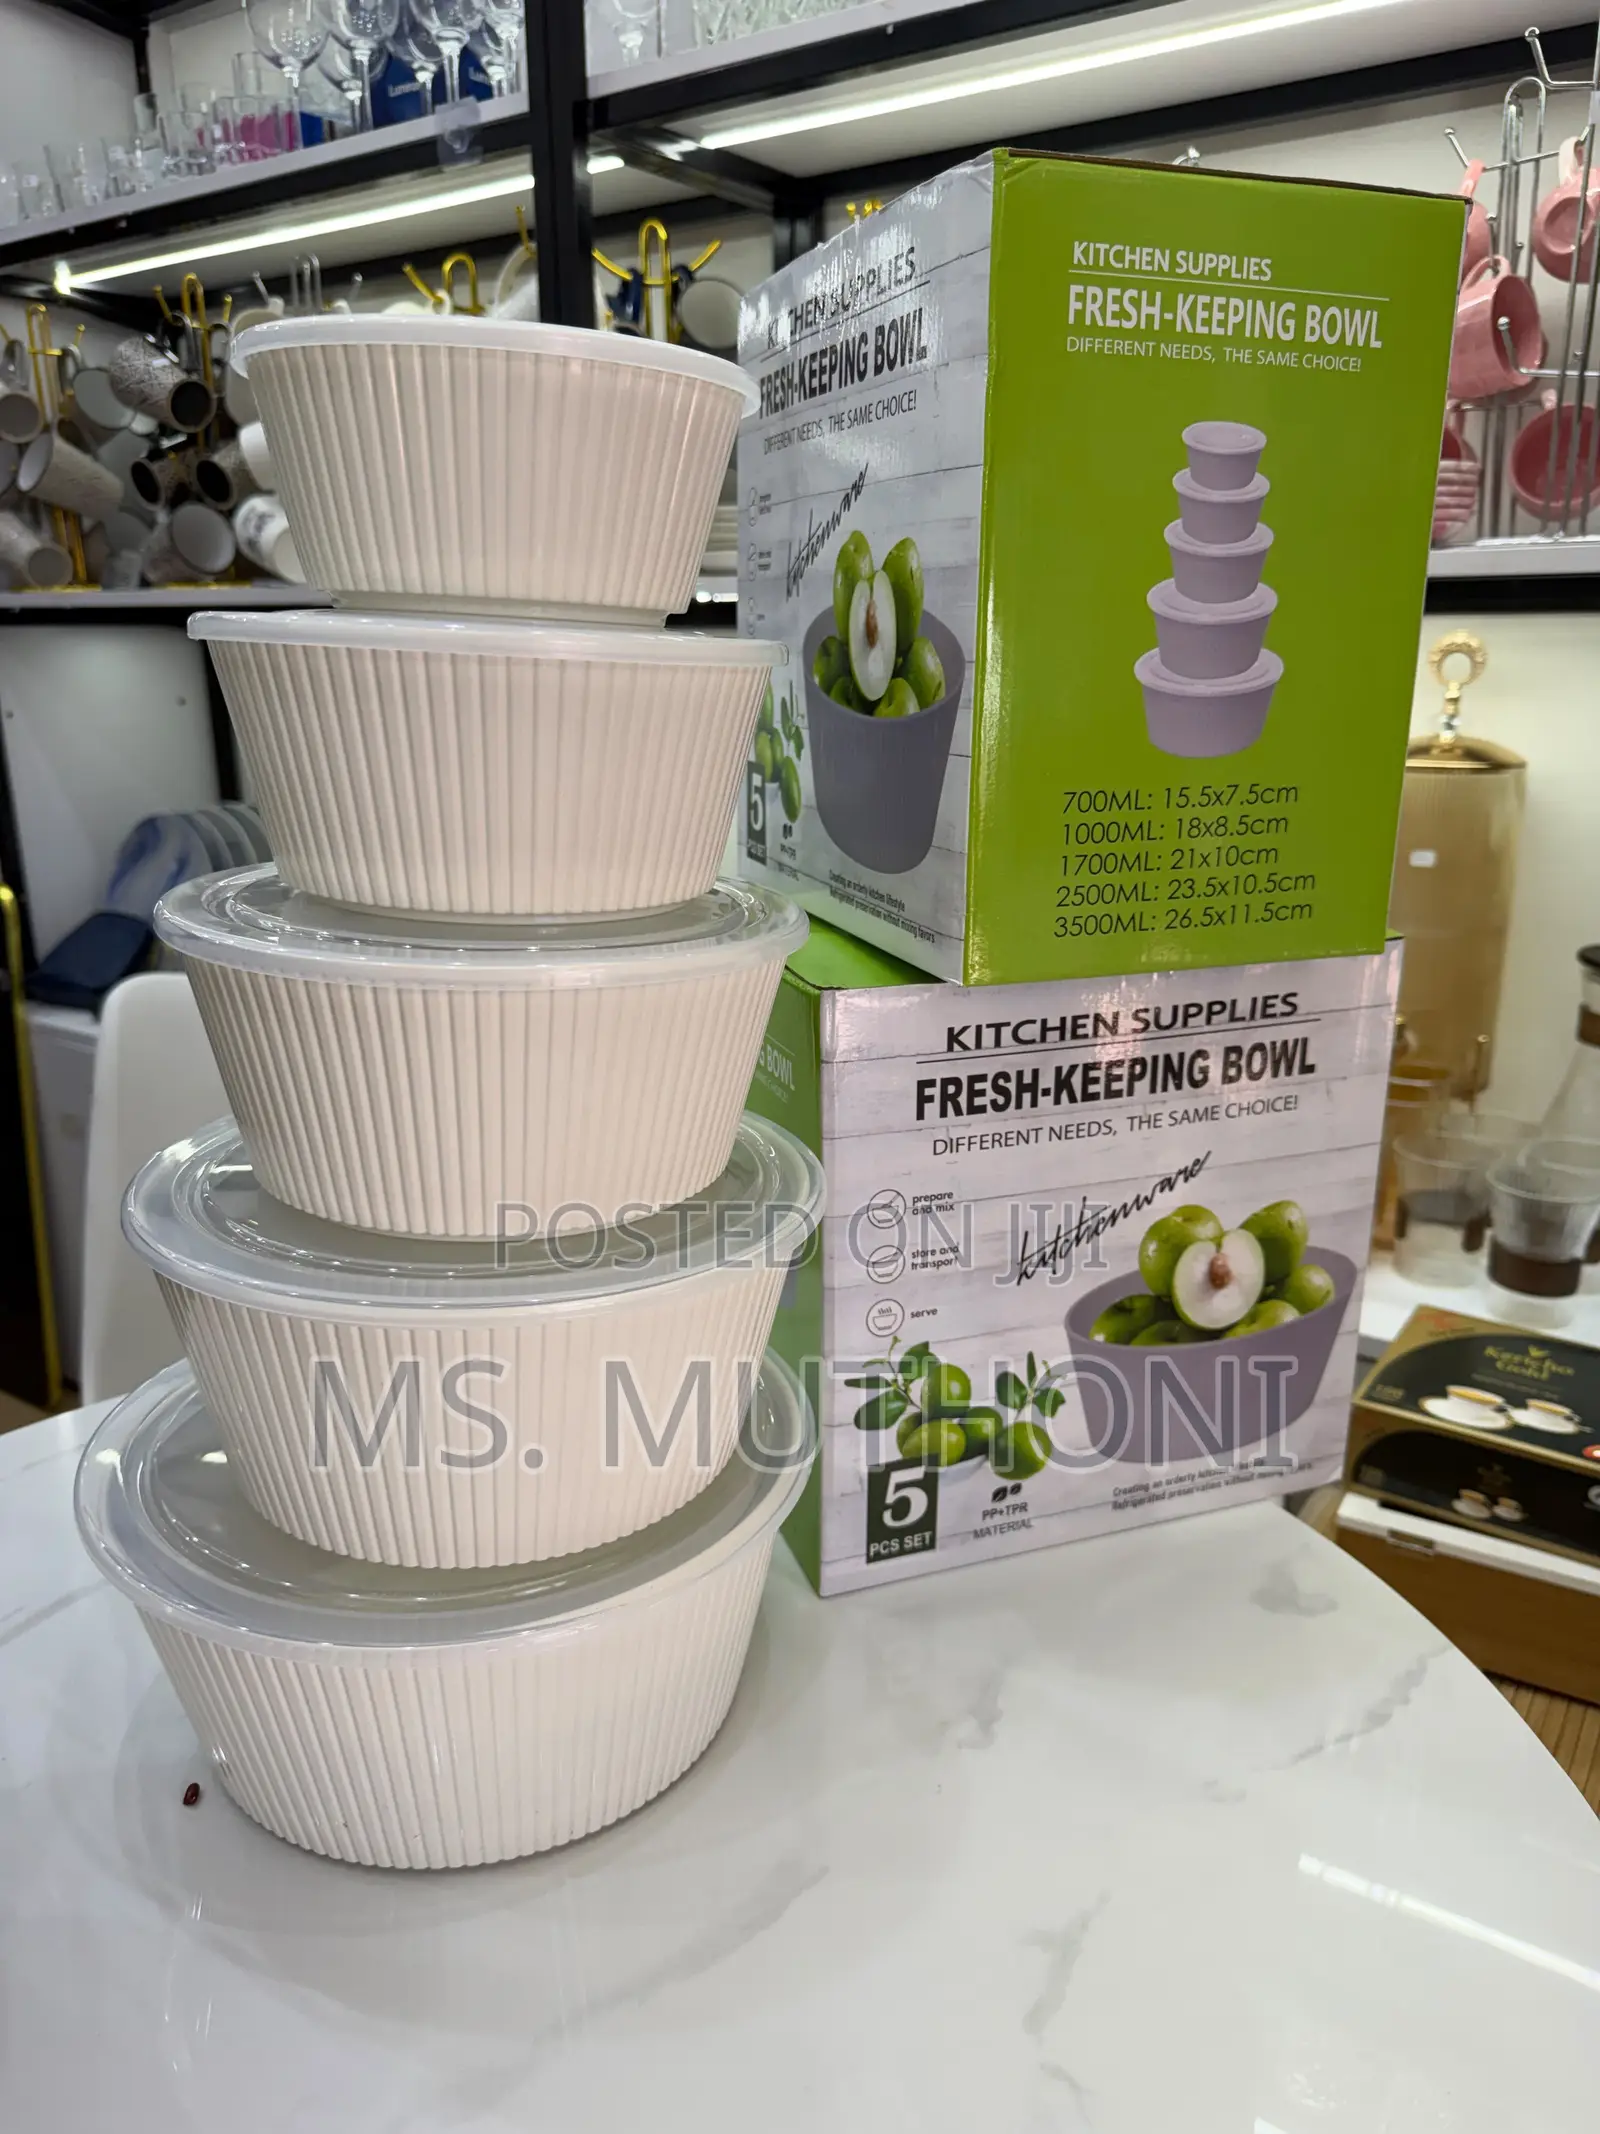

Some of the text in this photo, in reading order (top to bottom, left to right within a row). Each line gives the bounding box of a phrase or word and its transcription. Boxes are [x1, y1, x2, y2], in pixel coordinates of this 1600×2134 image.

[1072, 240, 1272, 281] KITCHEN SUPPLIES
[830, 246, 916, 317] SUPPLIES
[1067, 284, 1383, 348] FRESH-KEEPING BOWL
[760, 308, 928, 419] FRESH-KEEPING BOWL
[1066, 336, 1362, 373] DIFFERENT NEEDS, THE SAME CHOICE!
[828, 412, 845, 434] THE
[847, 403, 873, 429] SAME
[875, 389, 917, 420] CHOICE!
[750, 772, 763, 832] 5
[1062, 783, 1298, 814] 700ML: 15.5x7.5cm
[1063, 815, 1289, 845] 1000ML: 18x8.5cm
[1061, 845, 1279, 877] 1700ML: 21x10cm
[1056, 872, 1316, 908] 2500ML: 23.5x10.5cm
[1053, 902, 1313, 938] 3500ML: 26.5x11.5cm
[946, 991, 1299, 1053] KITCHEN SUPPLIES
[767, 1043, 796, 1092] BOWL
[916, 1037, 1316, 1121] FRESH-KEEPING BOWL
[932, 1095, 1298, 1156] DIFFERENT NEEDS, THE SAME CHOICE!
[912, 1191, 954, 1205] prepare
[912, 1202, 955, 1216] and mix
[1017, 1150, 1212, 1286] kitchenware
[911, 1257, 958, 1270] transport
[912, 1242, 960, 1259] store and
[910, 1308, 938, 1319] serve
[882, 1465, 929, 1528] 5
[982, 1501, 1028, 1521] PP+TPR
[869, 1531, 933, 1557] PCS SET
[972, 1518, 1034, 1540] MATERIAL
